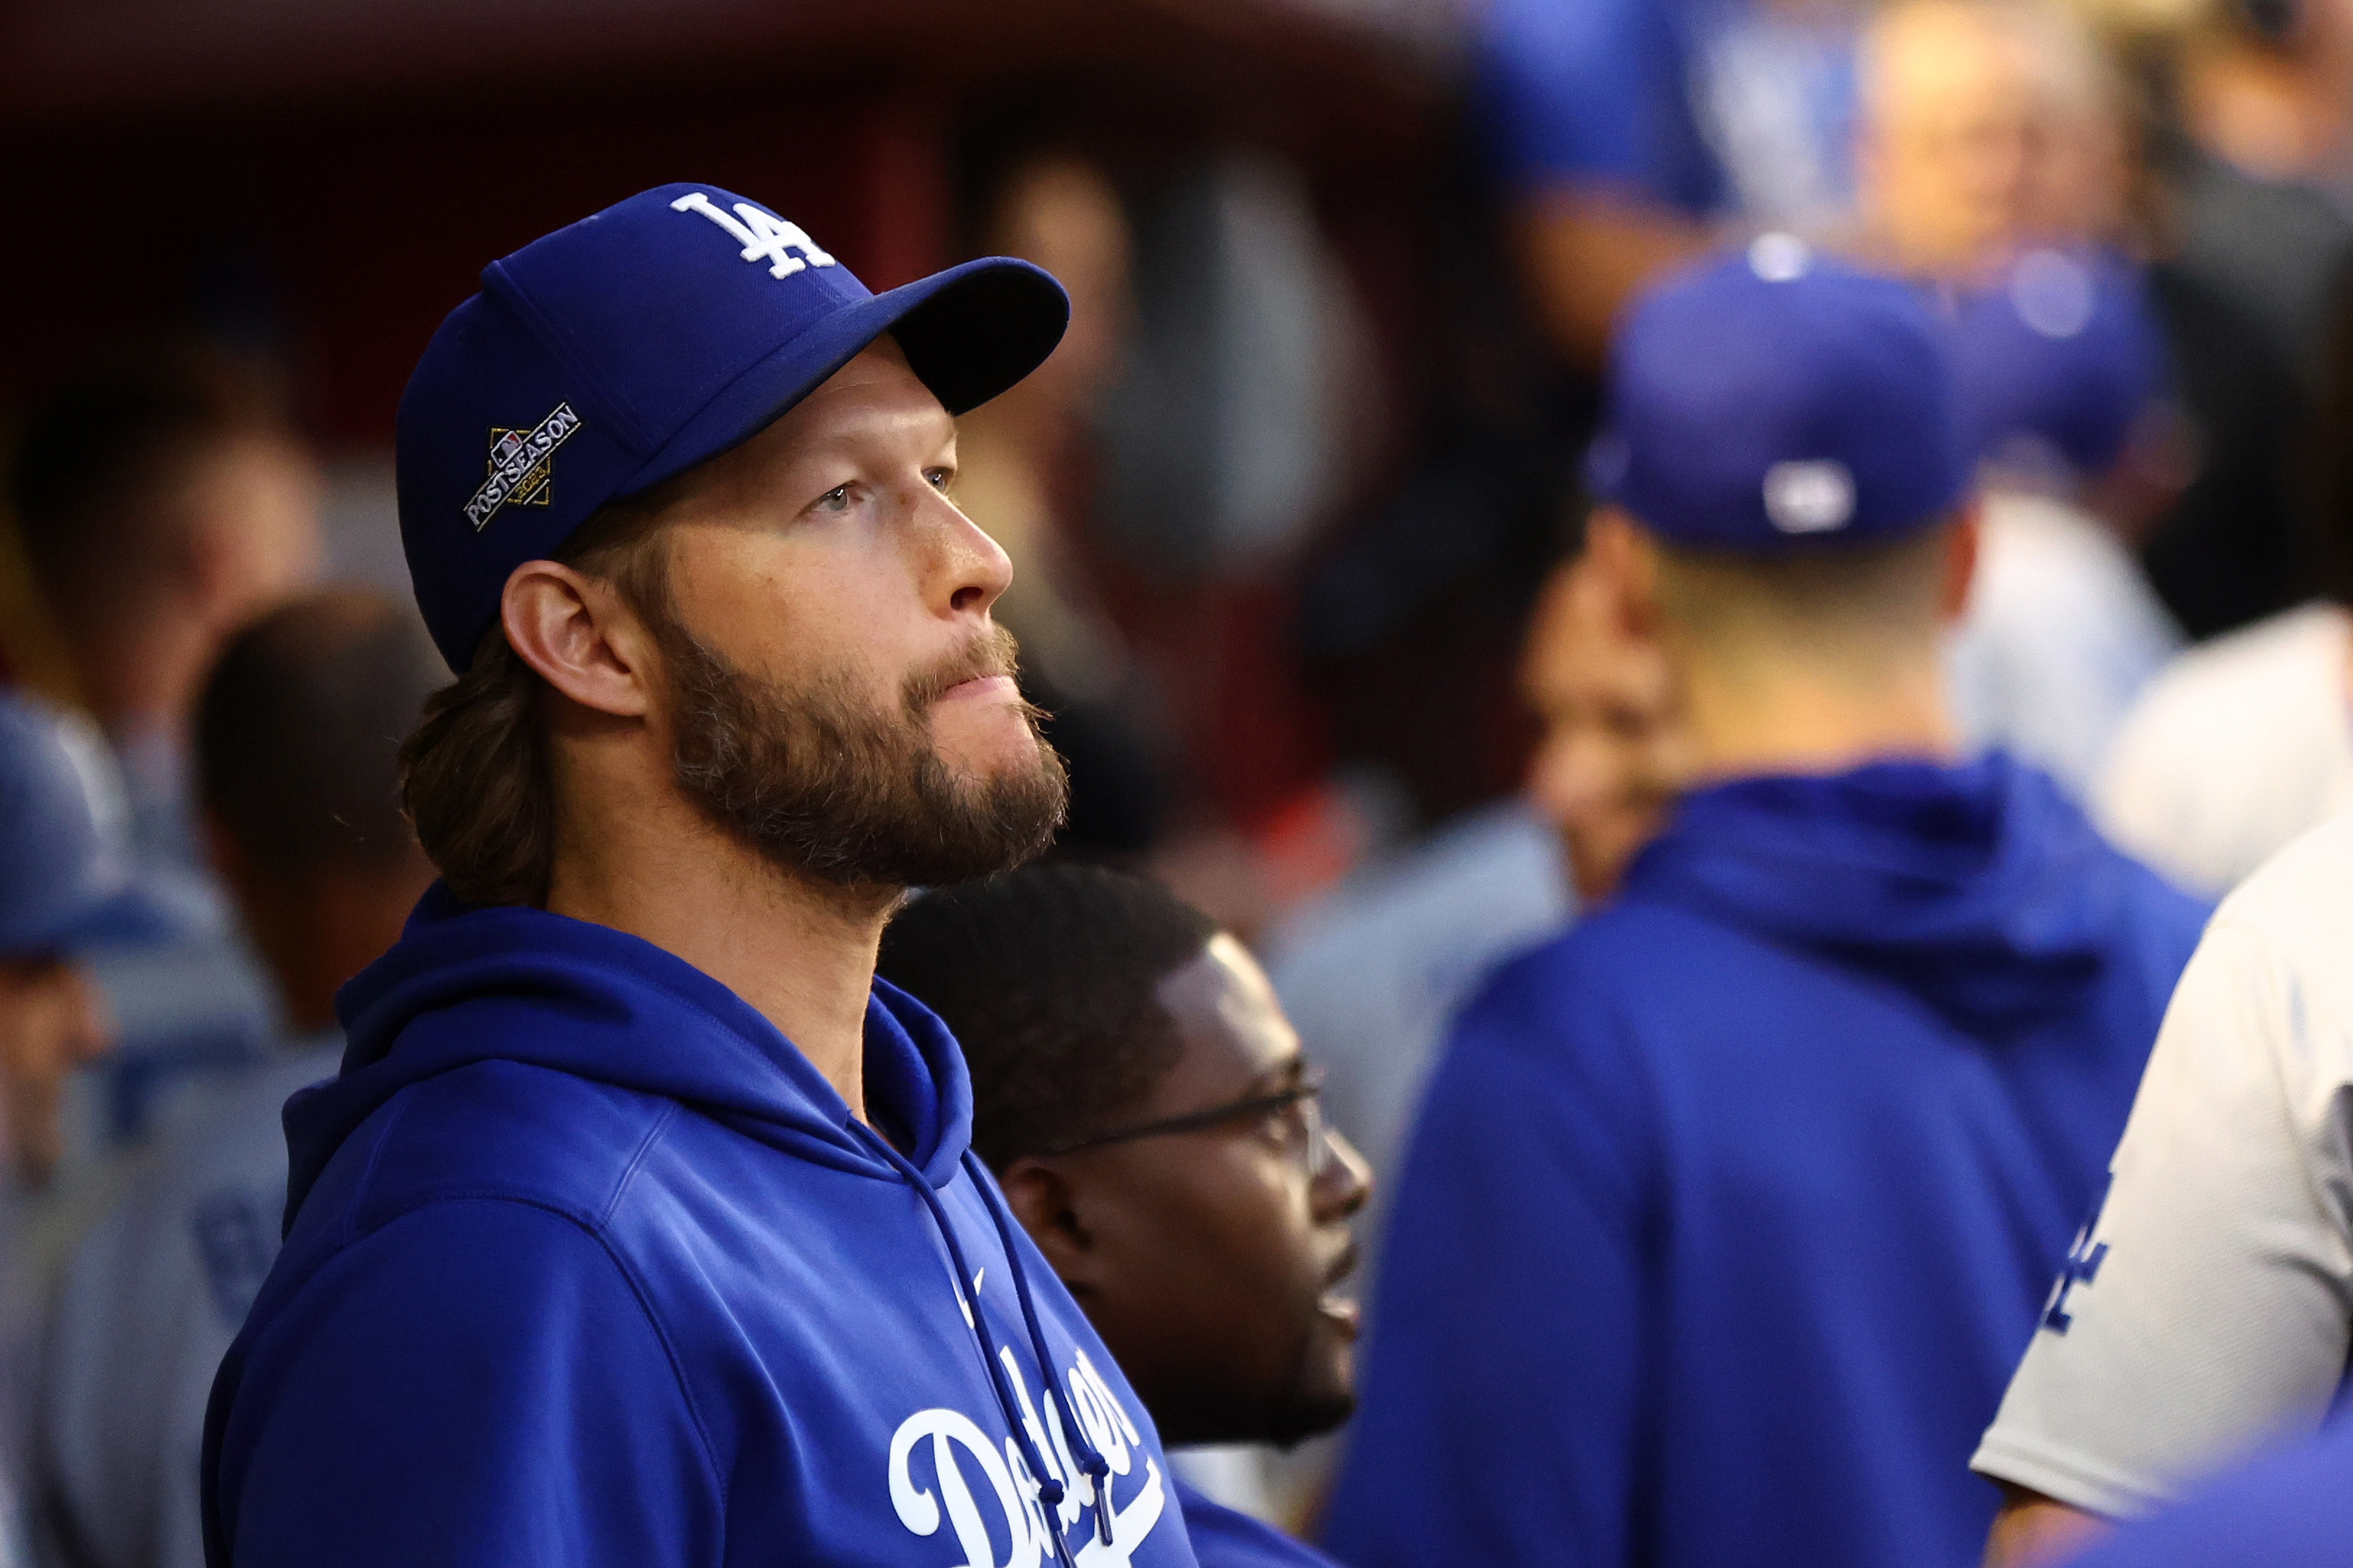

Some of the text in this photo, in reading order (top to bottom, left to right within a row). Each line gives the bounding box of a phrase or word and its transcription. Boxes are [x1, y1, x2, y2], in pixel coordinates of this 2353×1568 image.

[670, 192, 836, 280] LA
[467, 405, 578, 526] POSTSEASON
[515, 466, 546, 499] 2023
[889, 1345, 1156, 1568] Dodger
